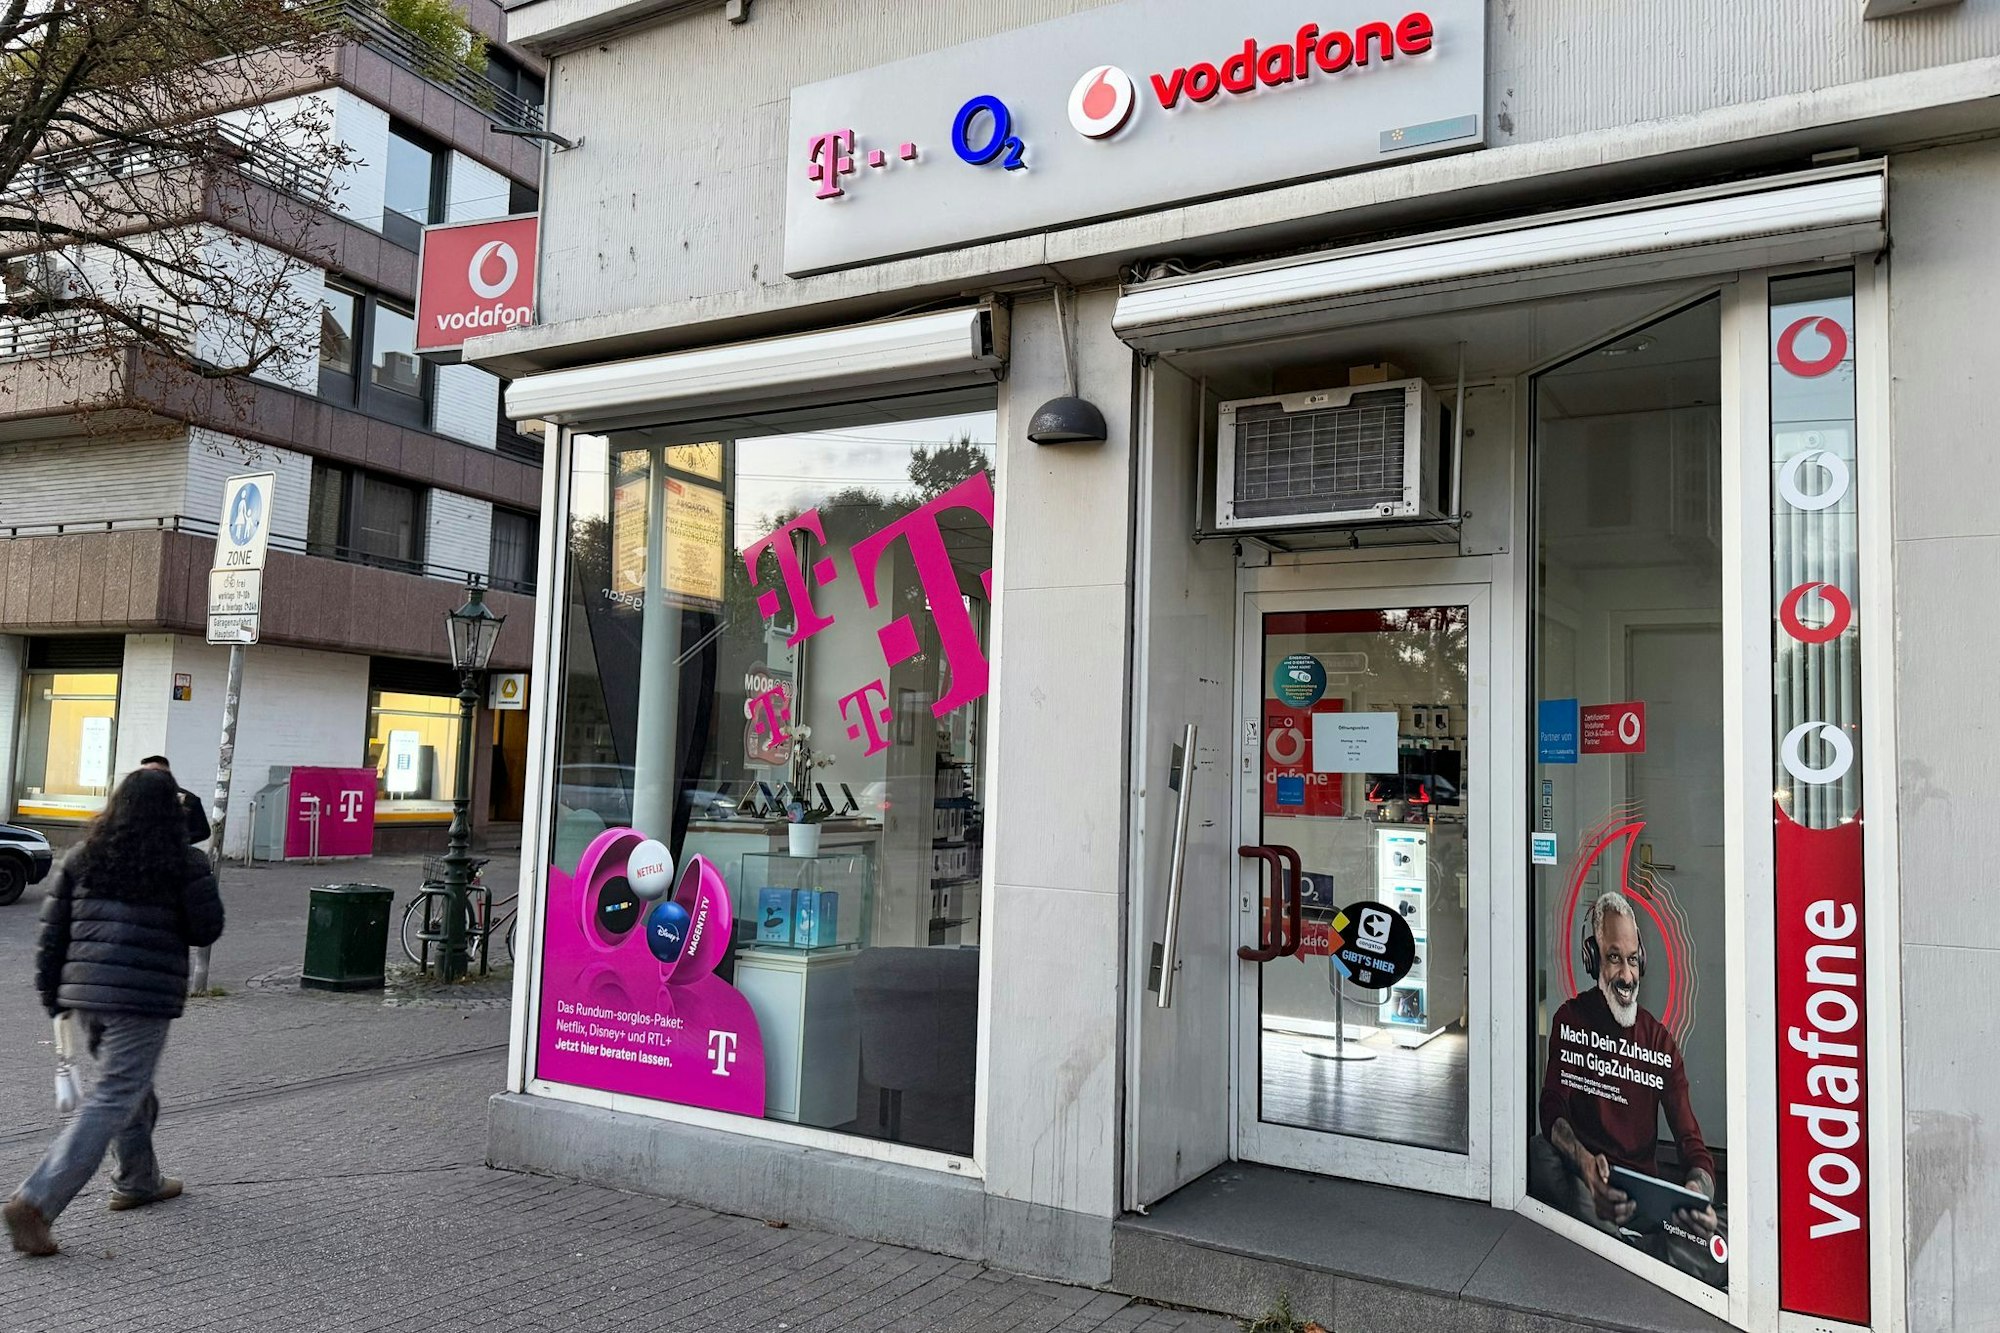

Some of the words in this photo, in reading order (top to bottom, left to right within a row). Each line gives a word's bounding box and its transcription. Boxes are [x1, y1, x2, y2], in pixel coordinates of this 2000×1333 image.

[1150, 11, 1434, 109] vodafone
[437, 303, 534, 330] vodafon
[226, 550, 252, 566] ZONE
[237, 579, 246, 588] frei
[213, 617, 252, 628] Garagenzufahrt
[1540, 732, 1560, 742] Partner
[1562, 733, 1572, 741] von
[340, 790, 363, 822] T
[637, 862, 664, 879] NETFLIX
[687, 909, 708, 956] MAGENTA
[1358, 940, 1384, 951] congstar
[1342, 949, 1372, 967] GIBT'S
[1373, 959, 1395, 974] HIER
[557, 1000, 574, 1014] Das
[576, 1003, 683, 1030] Rundum-sorglos-Paket:
[556, 1019, 588, 1037] Netflix,
[589, 1023, 626, 1042] Disney+
[628, 1031, 645, 1044] und
[648, 1032, 673, 1047] RTL+
[1560, 1023, 1589, 1046] Mach
[1591, 1031, 1616, 1054] Dein
[1619, 1038, 1672, 1069] Zuhause
[555, 1037, 579, 1052] Jetzt
[580, 1041, 598, 1056] hier
[600, 1044, 636, 1062] beraten
[638, 1050, 673, 1067] lassen.
[707, 1030, 737, 1076] T
[1560, 1049, 1584, 1067] zum
[1587, 1052, 1664, 1090] GigaZuhause
[1560, 1069, 1584, 1082] Zusammen
[1788, 899, 1861, 1240] vodafone
[1663, 1220, 1687, 1238] Together
[1687, 1232, 1696, 1242] we
[1696, 1236, 1707, 1247] can
